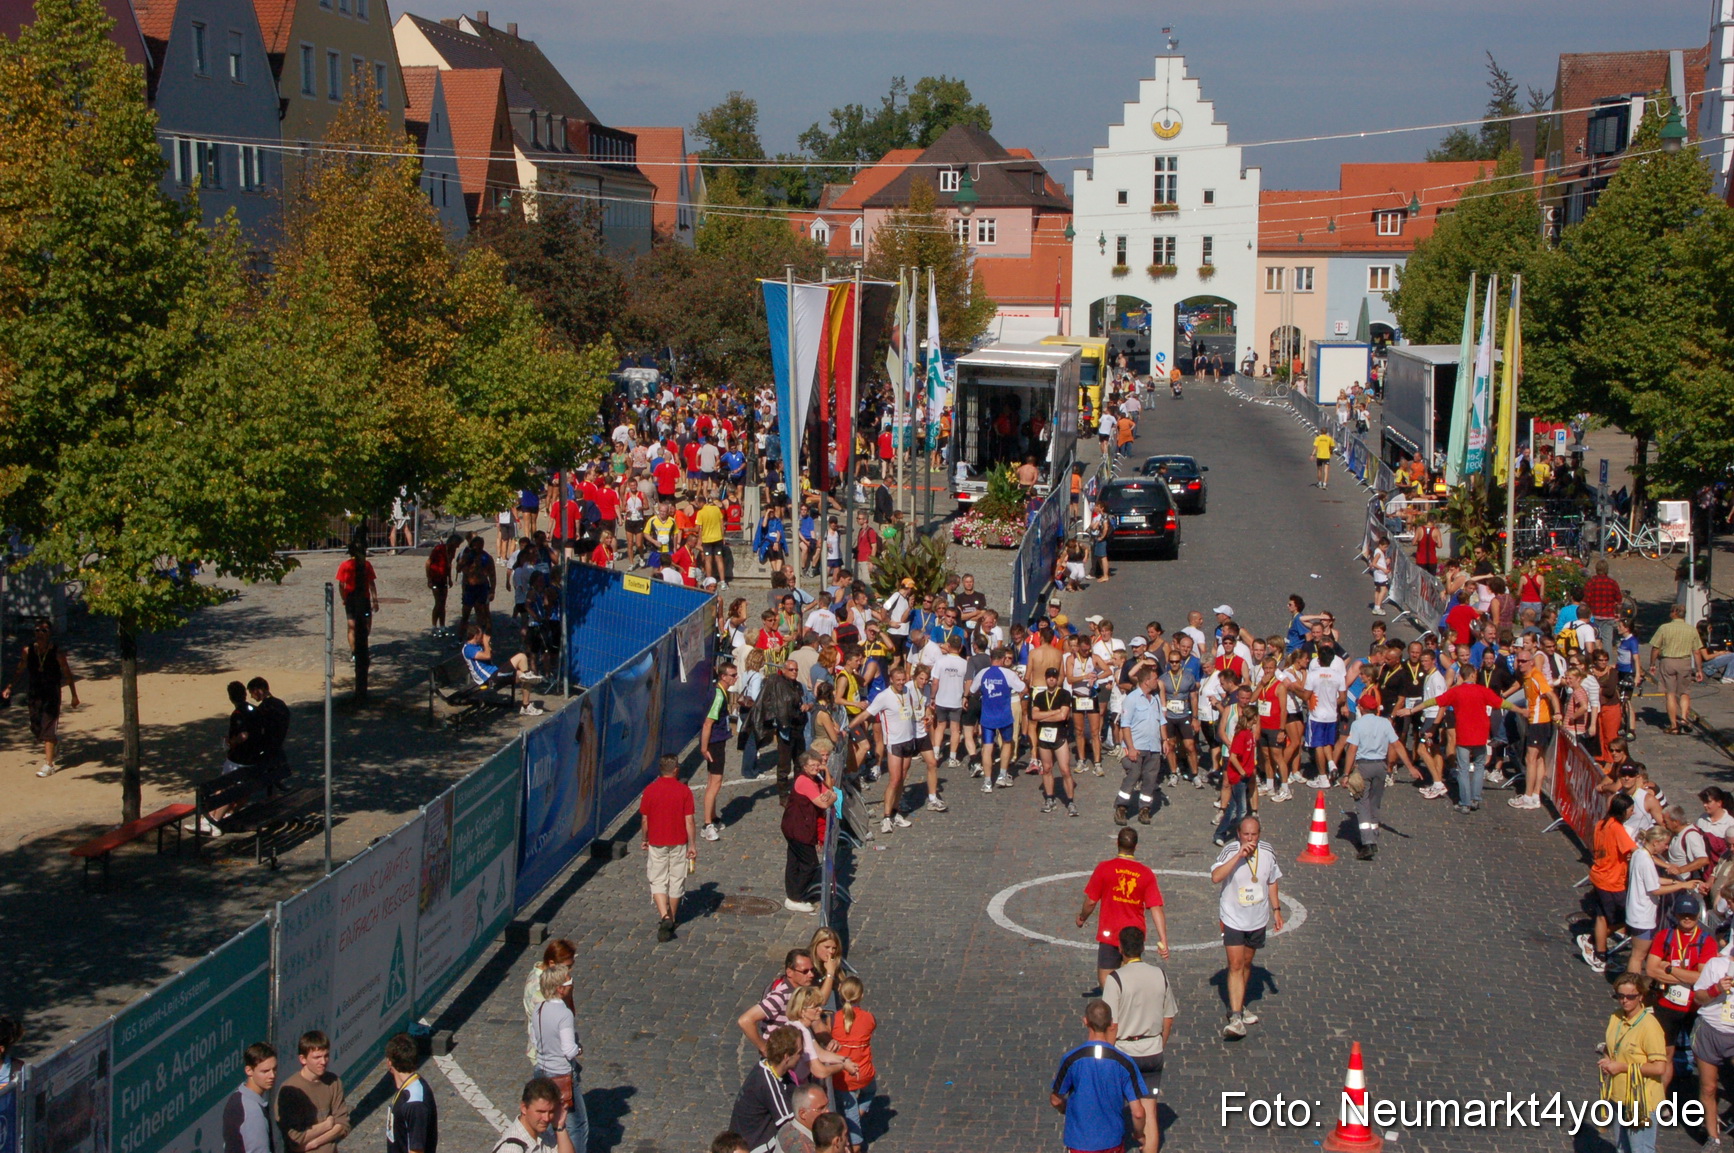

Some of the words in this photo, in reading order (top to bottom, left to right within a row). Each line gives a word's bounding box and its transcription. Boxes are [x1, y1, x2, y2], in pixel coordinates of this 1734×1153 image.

[627, 579, 645, 590] Toiletten
[455, 825, 474, 855] Mehr
[474, 797, 505, 842] Sicherheit
[454, 856, 466, 883] für
[465, 846, 477, 873] Ihr
[339, 902, 380, 952] EINFACH
[381, 876, 416, 920] BESSER
[340, 883, 358, 916] MIT
[121, 1025, 138, 1046] JGS
[138, 976, 211, 1035] Event-Leit-Systeme
[120, 1091, 185, 1153] sicheren
[188, 1039, 245, 1105] Bahnen!
[121, 1078, 151, 1119] Fun
[155, 1061, 168, 1093] &
[170, 1030, 217, 1082] Action
[219, 1016, 234, 1045] in
